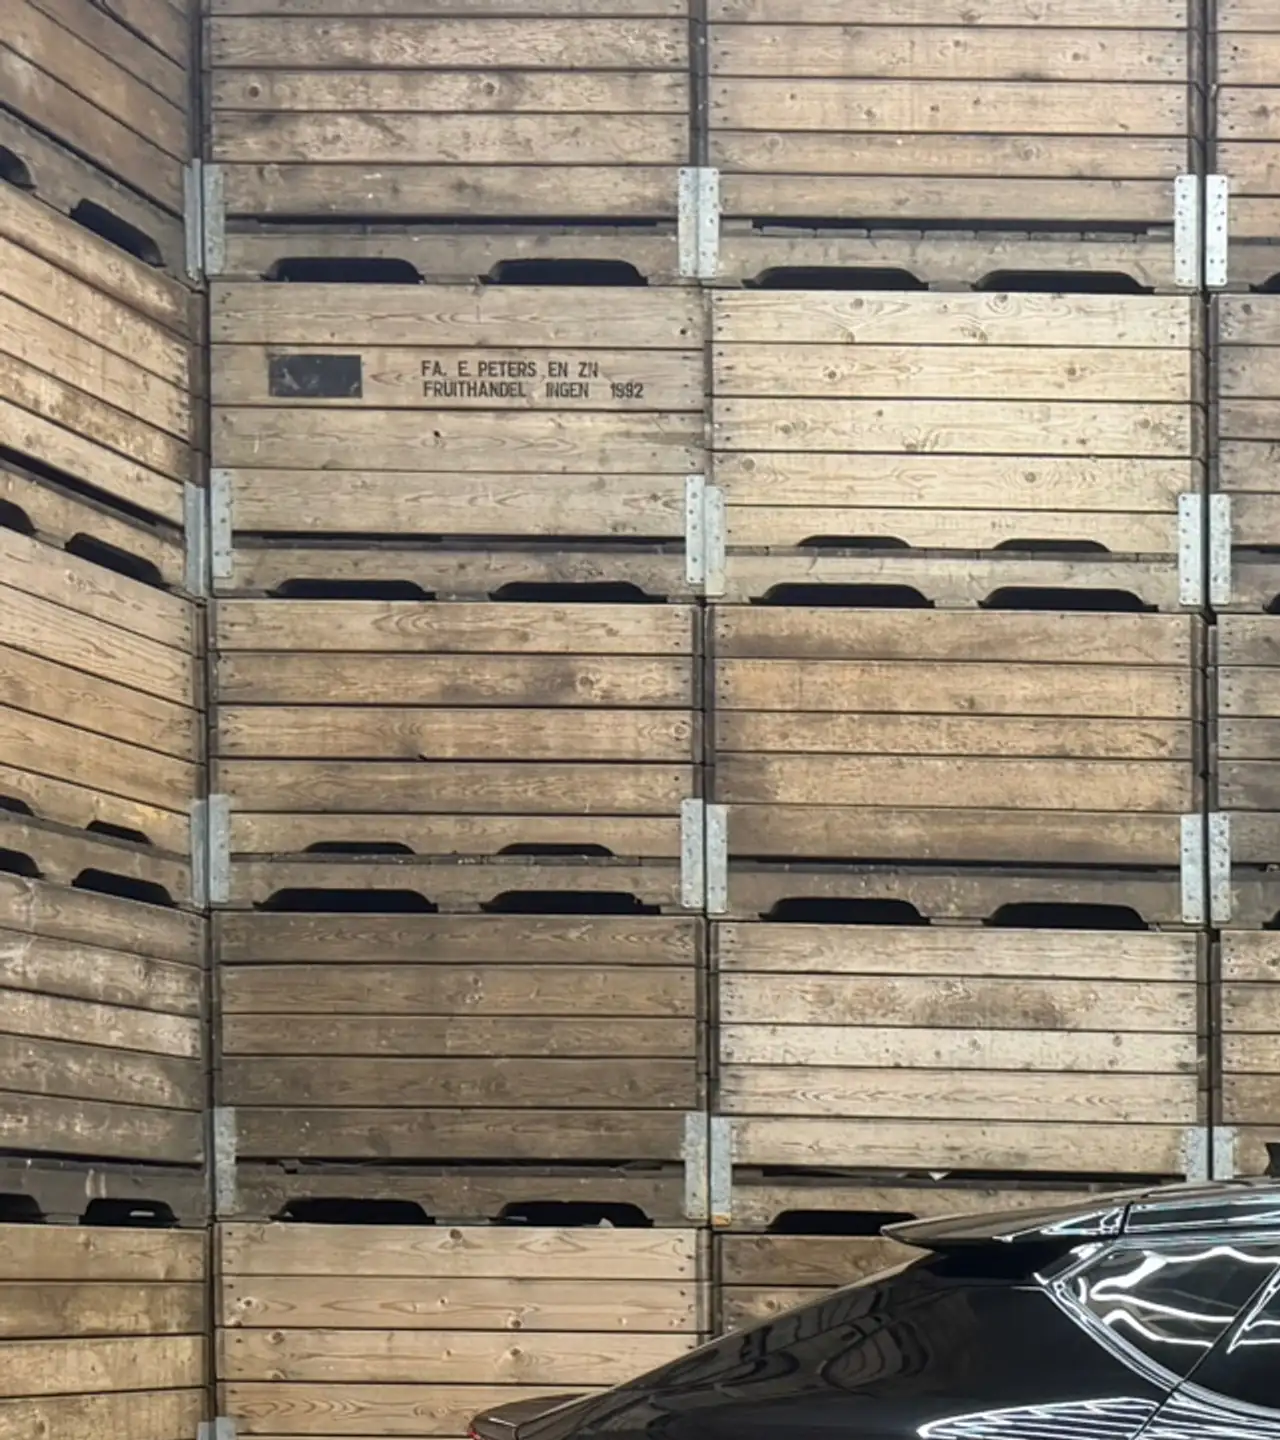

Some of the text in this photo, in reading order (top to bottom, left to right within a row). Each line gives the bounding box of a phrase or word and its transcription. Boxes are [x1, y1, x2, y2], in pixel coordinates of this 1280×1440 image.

[420, 360, 448, 378] FA.
[477, 360, 536, 378] PETERS
[547, 361, 568, 378] EN
[577, 361, 600, 378] ZN
[422, 381, 645, 399] FRUITHANDEL INGEN 1992
